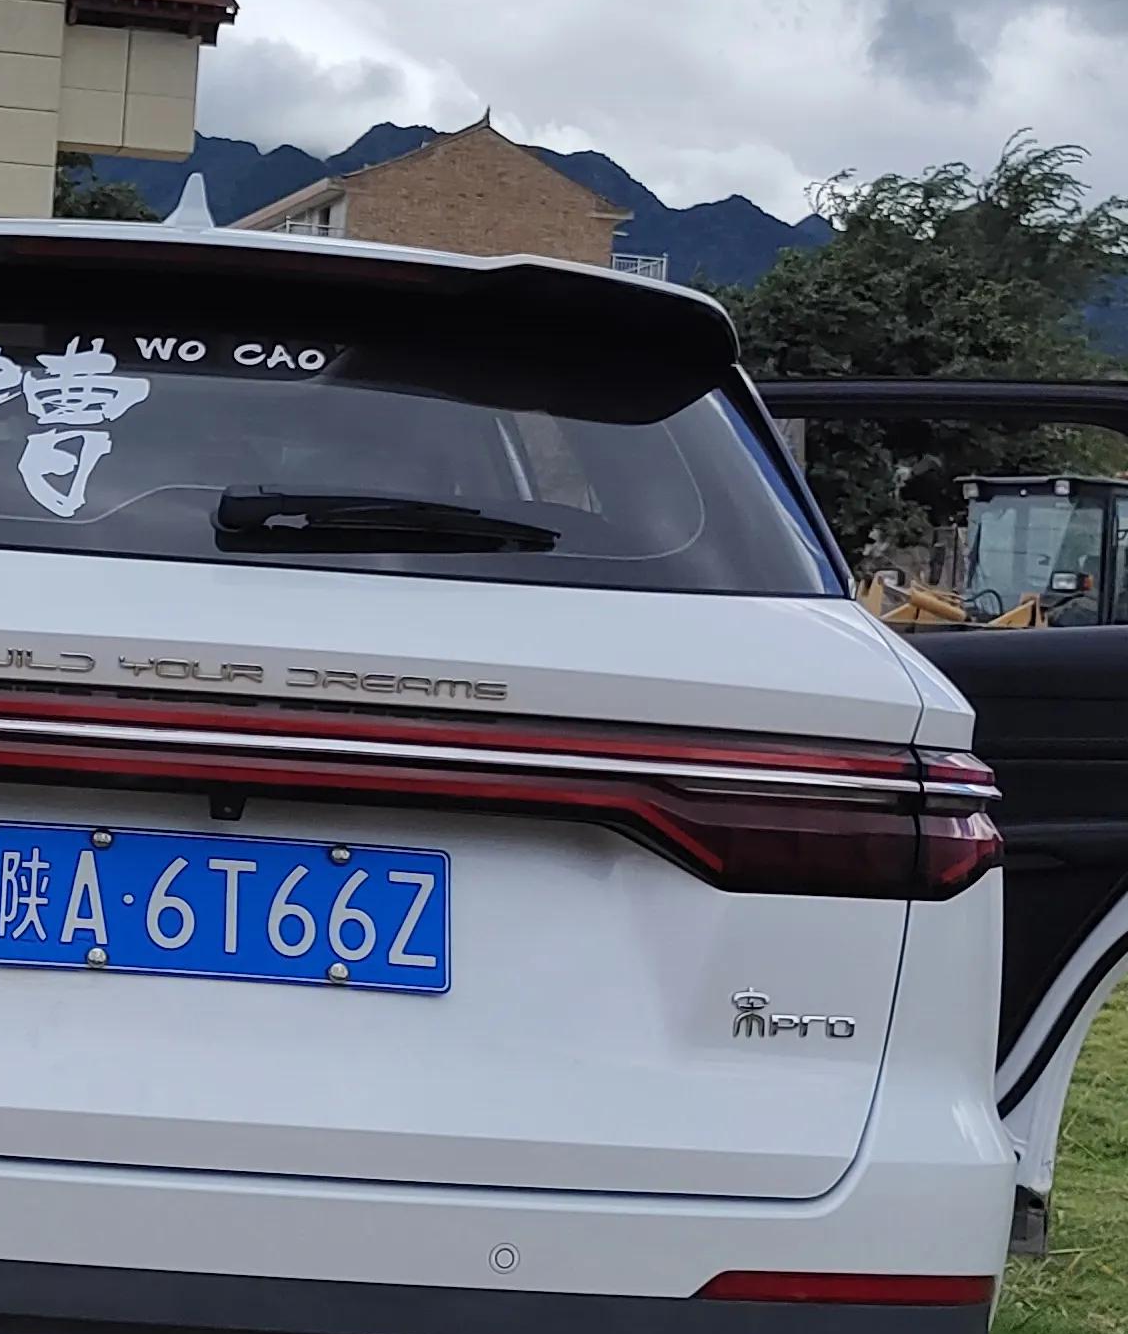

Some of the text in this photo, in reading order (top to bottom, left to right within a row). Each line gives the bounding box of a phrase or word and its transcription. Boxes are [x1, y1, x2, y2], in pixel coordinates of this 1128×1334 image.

[134, 336, 326, 371] WO CAO
[118, 654, 264, 684] YOUR
[286, 667, 509, 701] DREAMS
